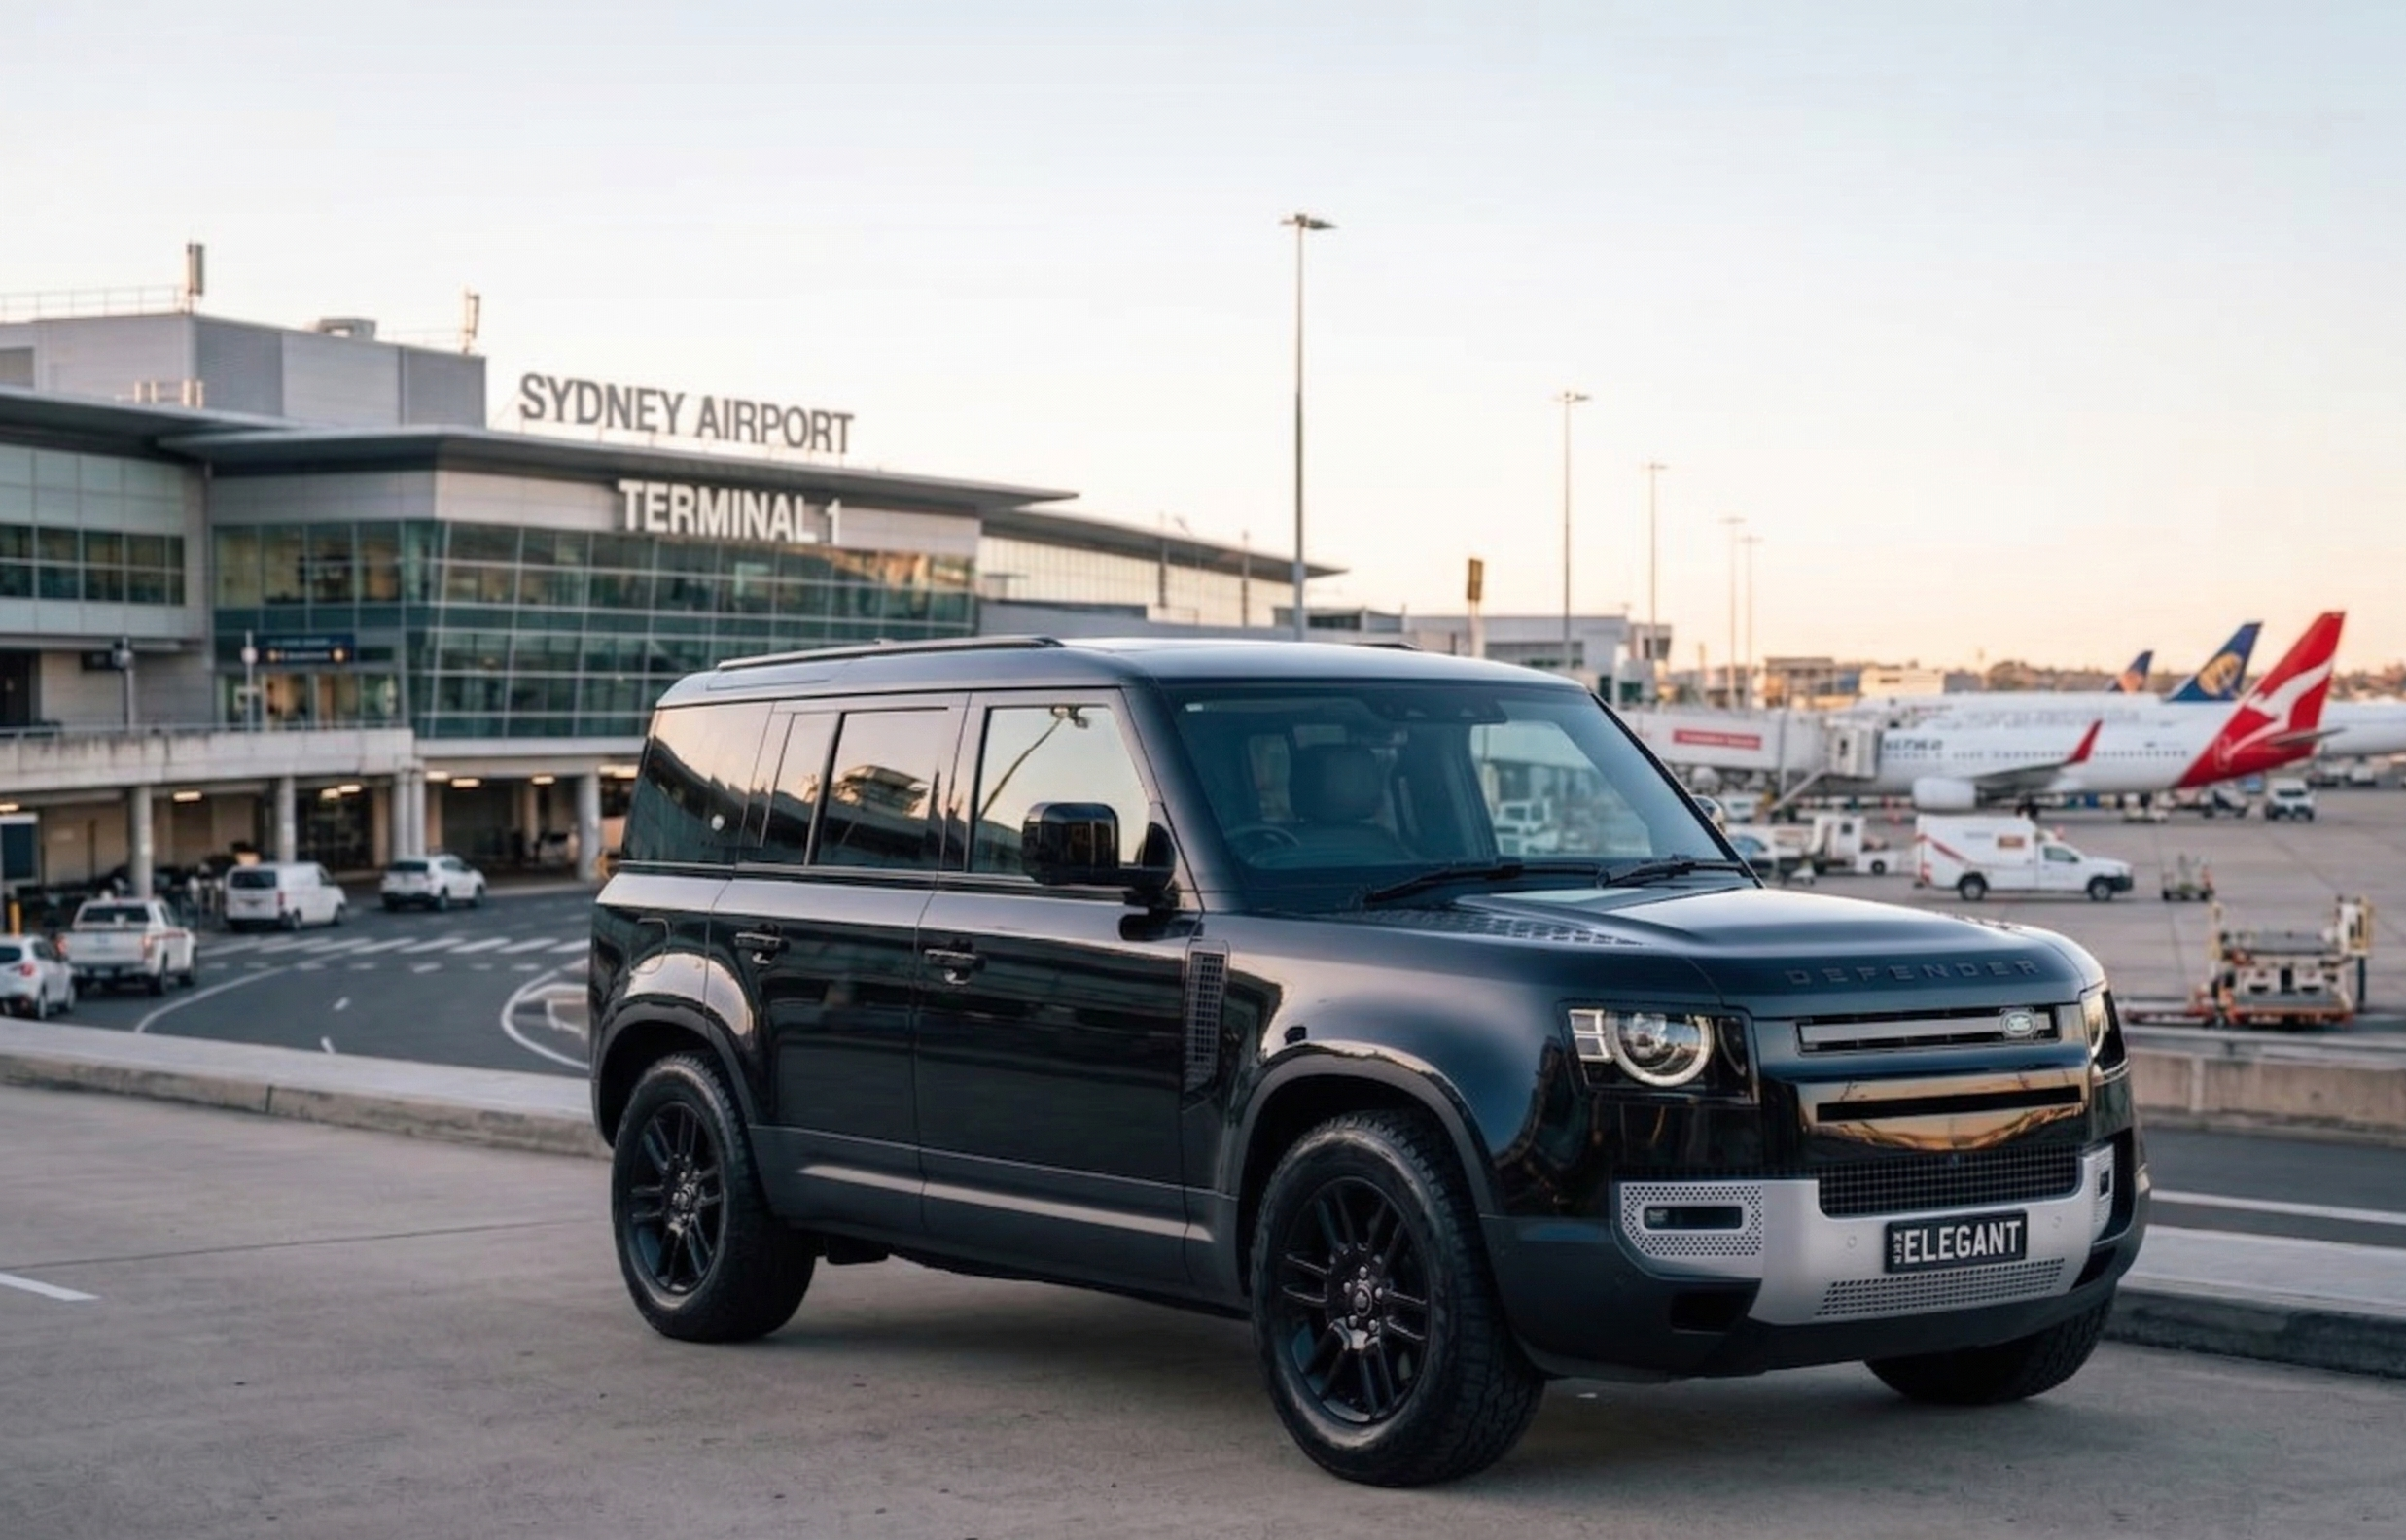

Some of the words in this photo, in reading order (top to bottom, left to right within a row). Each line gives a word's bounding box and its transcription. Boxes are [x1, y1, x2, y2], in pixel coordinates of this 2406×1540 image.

[519, 372, 685, 435] SYDNEY
[695, 395, 855, 454] AIRPORT
[618, 479, 817, 543] TERMINAL
[826, 498, 841, 545] 1
[1786, 959, 2040, 986] DEFENDER
[1904, 1220, 2022, 1264] ELEGANT
